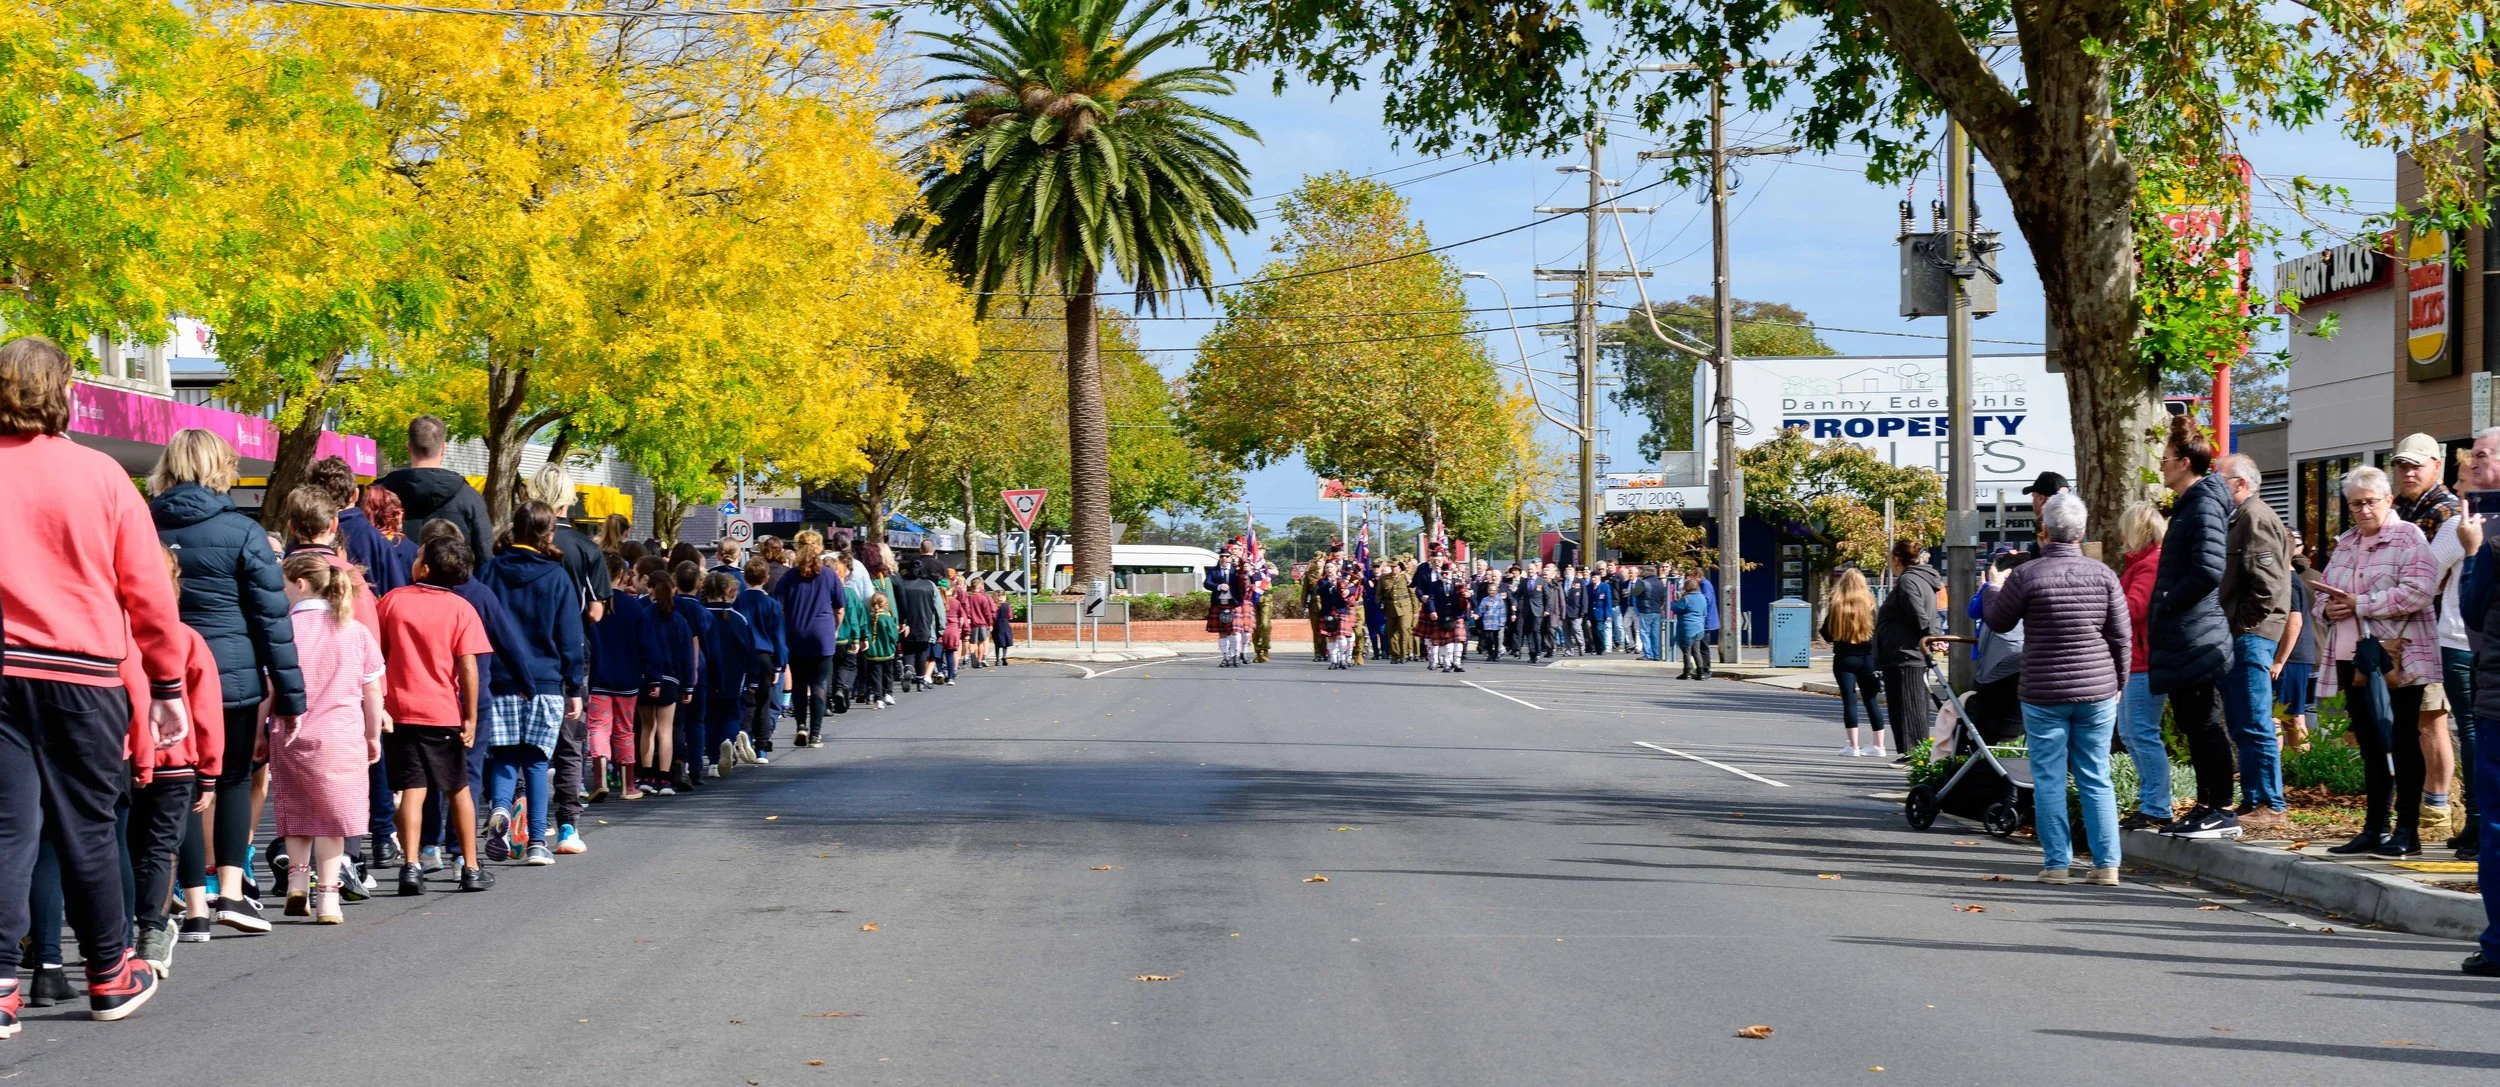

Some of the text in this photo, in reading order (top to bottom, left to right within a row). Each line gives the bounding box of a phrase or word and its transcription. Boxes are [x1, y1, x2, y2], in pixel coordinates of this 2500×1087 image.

[1782, 397, 1871, 411] Danny
[1616, 491, 1683, 506] 5127 2000
[732, 525, 748, 537] 40
